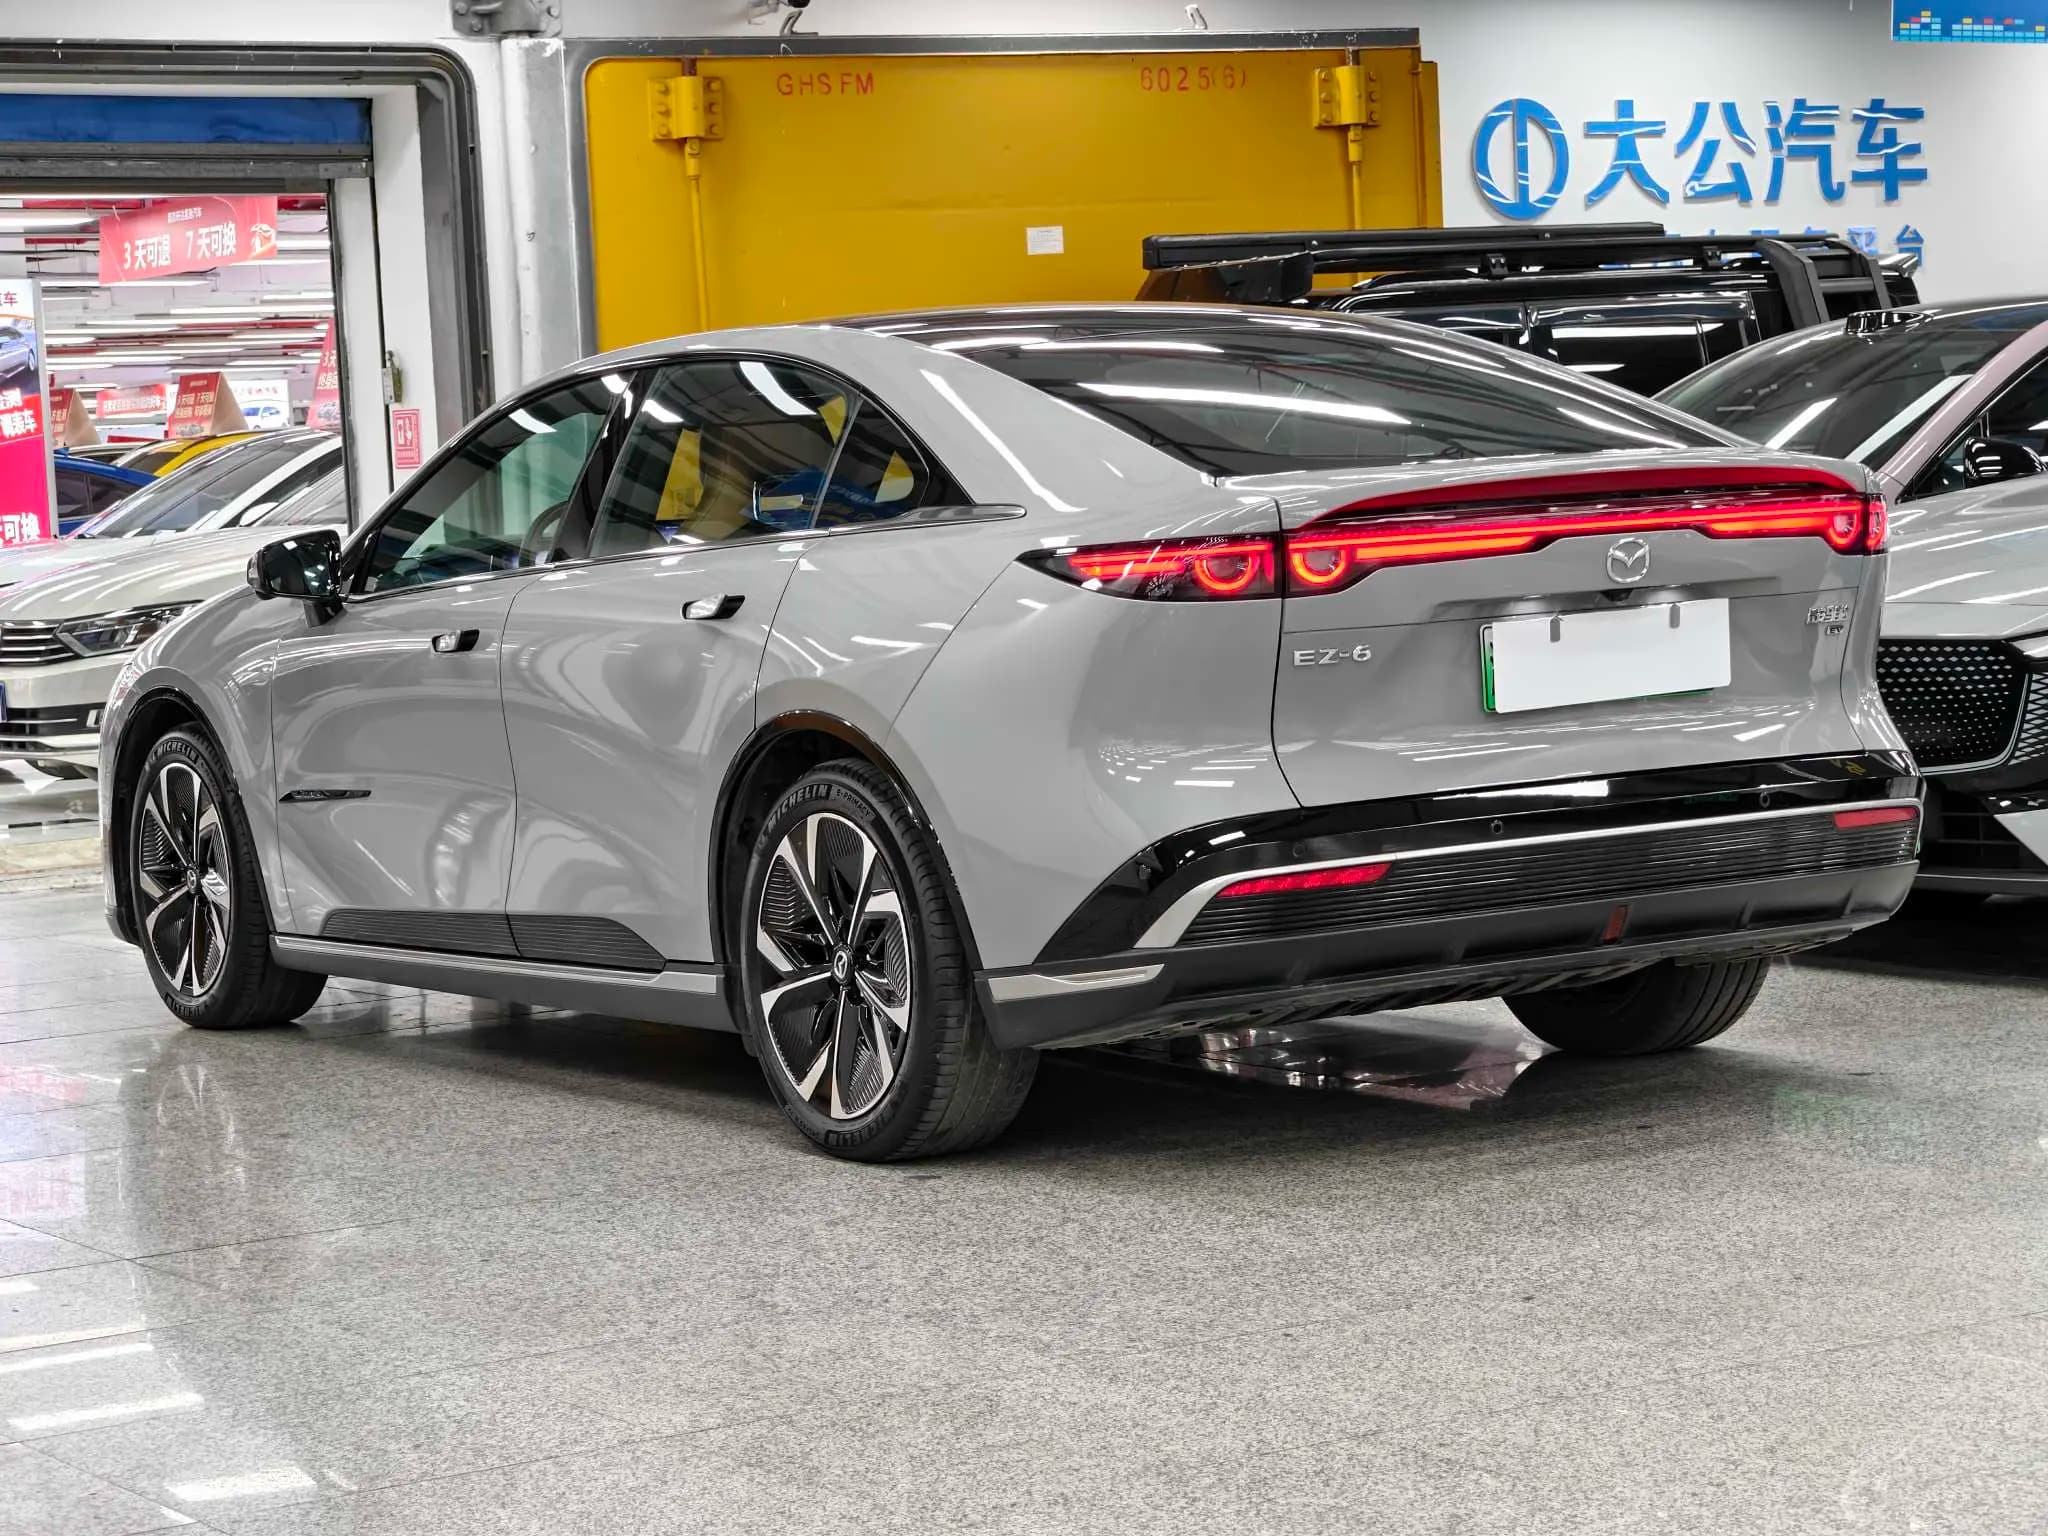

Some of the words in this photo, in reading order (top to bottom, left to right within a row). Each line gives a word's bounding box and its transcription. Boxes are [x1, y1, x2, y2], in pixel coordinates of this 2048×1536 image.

[1584, 98, 1927, 208] 大公汽车
[0, 291, 18, 306] 车
[0, 512, 40, 545] 可换
[1294, 645, 1371, 666] EZ-6
[157, 741, 197, 761] MICHELIN
[768, 783, 829, 833] MICHELIN
